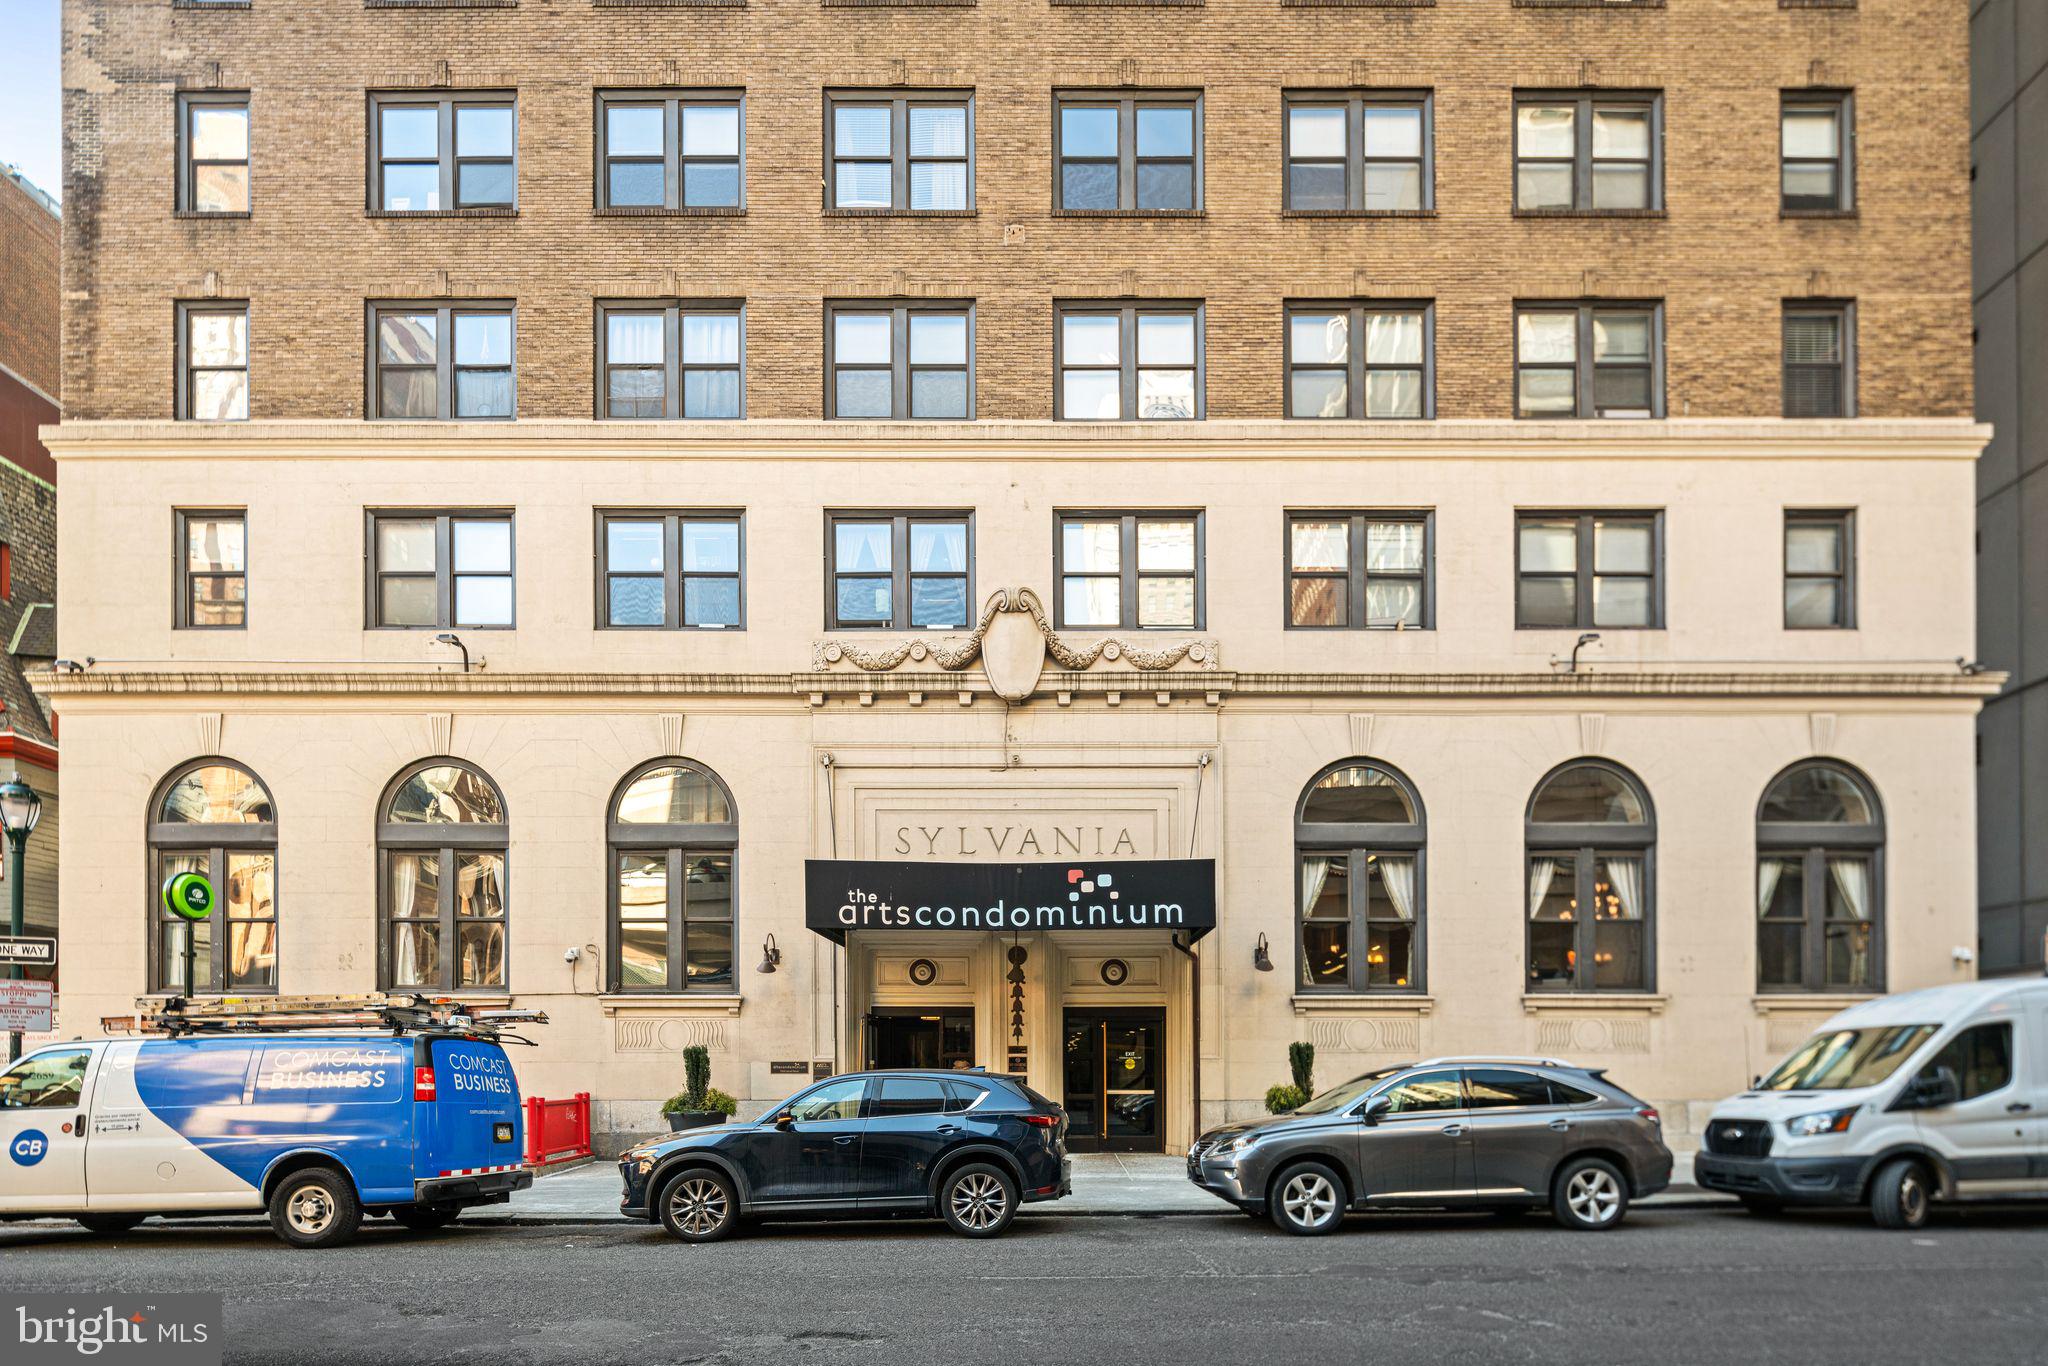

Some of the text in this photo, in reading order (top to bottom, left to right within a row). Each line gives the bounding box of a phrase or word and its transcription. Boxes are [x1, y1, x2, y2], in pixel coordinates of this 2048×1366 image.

[895, 826, 1137, 856] SYLVANIA
[188, 896, 207, 905] PATCO
[848, 888, 878, 904] the
[21, 945, 45, 956] WAY
[2, 990, 38, 998] STOPPING
[274, 1049, 391, 1068] COMCAST
[449, 1053, 507, 1075] COMCAST
[270, 1070, 386, 1090] BUSINESS
[453, 1073, 511, 1094] BUSINESS
[15, 1140, 42, 1156] CB
